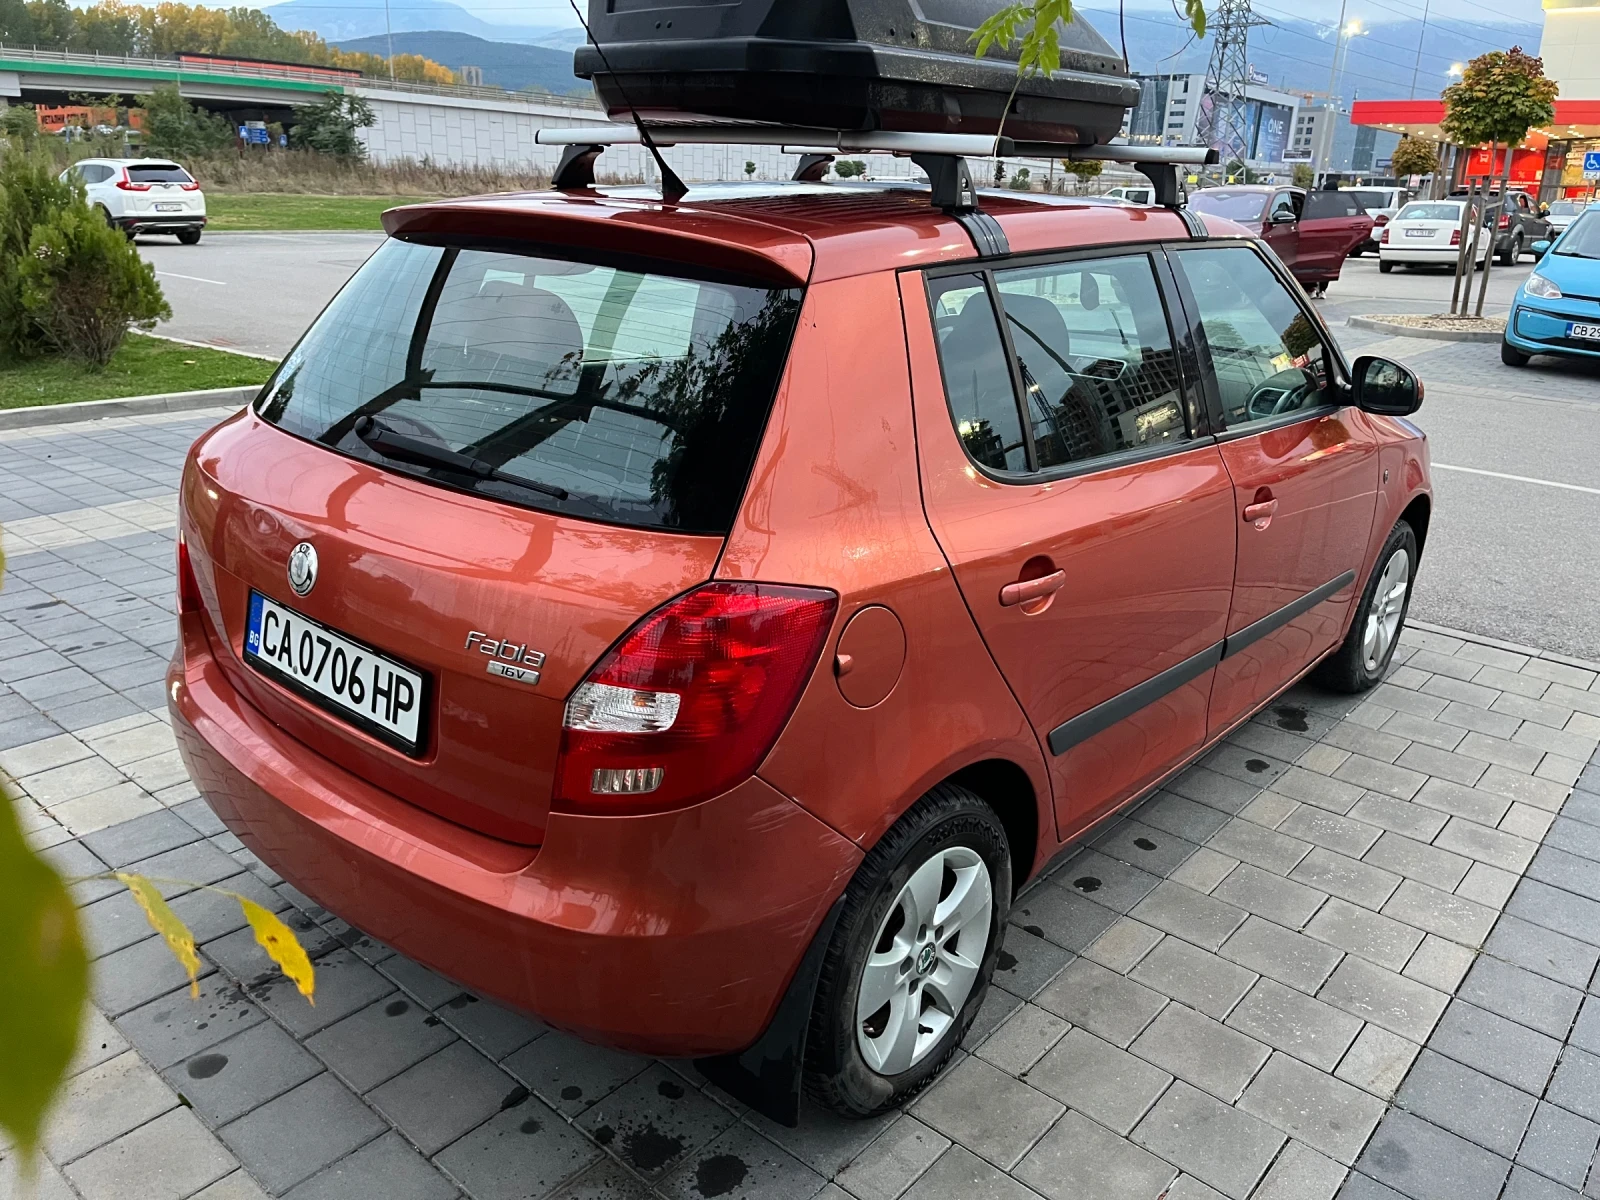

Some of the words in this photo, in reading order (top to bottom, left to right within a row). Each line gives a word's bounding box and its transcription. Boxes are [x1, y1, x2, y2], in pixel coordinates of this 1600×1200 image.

[1267, 118, 1284, 135] ONE
[1573, 325, 1588, 336] CB
[249, 630, 260, 647] BG
[464, 630, 547, 670] Fabia
[263, 609, 293, 668] CA
[299, 629, 365, 705] 0706
[371, 664, 415, 725] HP
[500, 665, 526, 680] 16V
